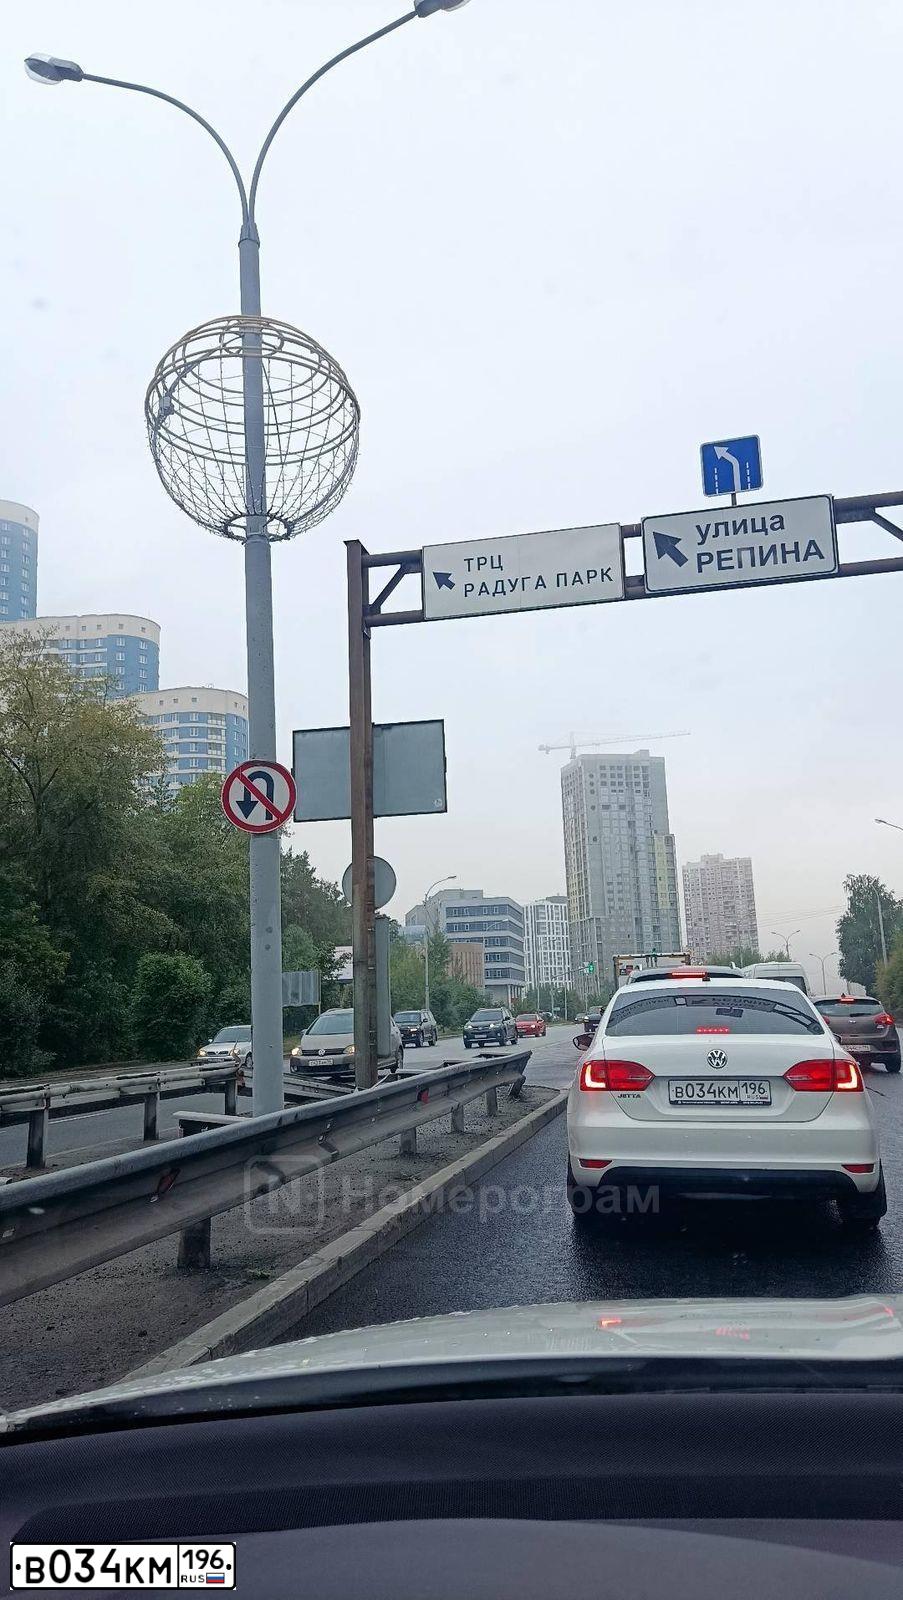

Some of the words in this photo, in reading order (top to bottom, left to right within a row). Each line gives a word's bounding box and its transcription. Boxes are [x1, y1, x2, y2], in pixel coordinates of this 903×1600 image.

[696, 513, 785, 546] улица
[464, 554, 504, 572] ТРЦ
[696, 538, 826, 574] РЕПИНА
[464, 574, 548, 598] РАДУГА
[556, 566, 615, 589] ПАРК
[741, 1081, 766, 1095] 196
